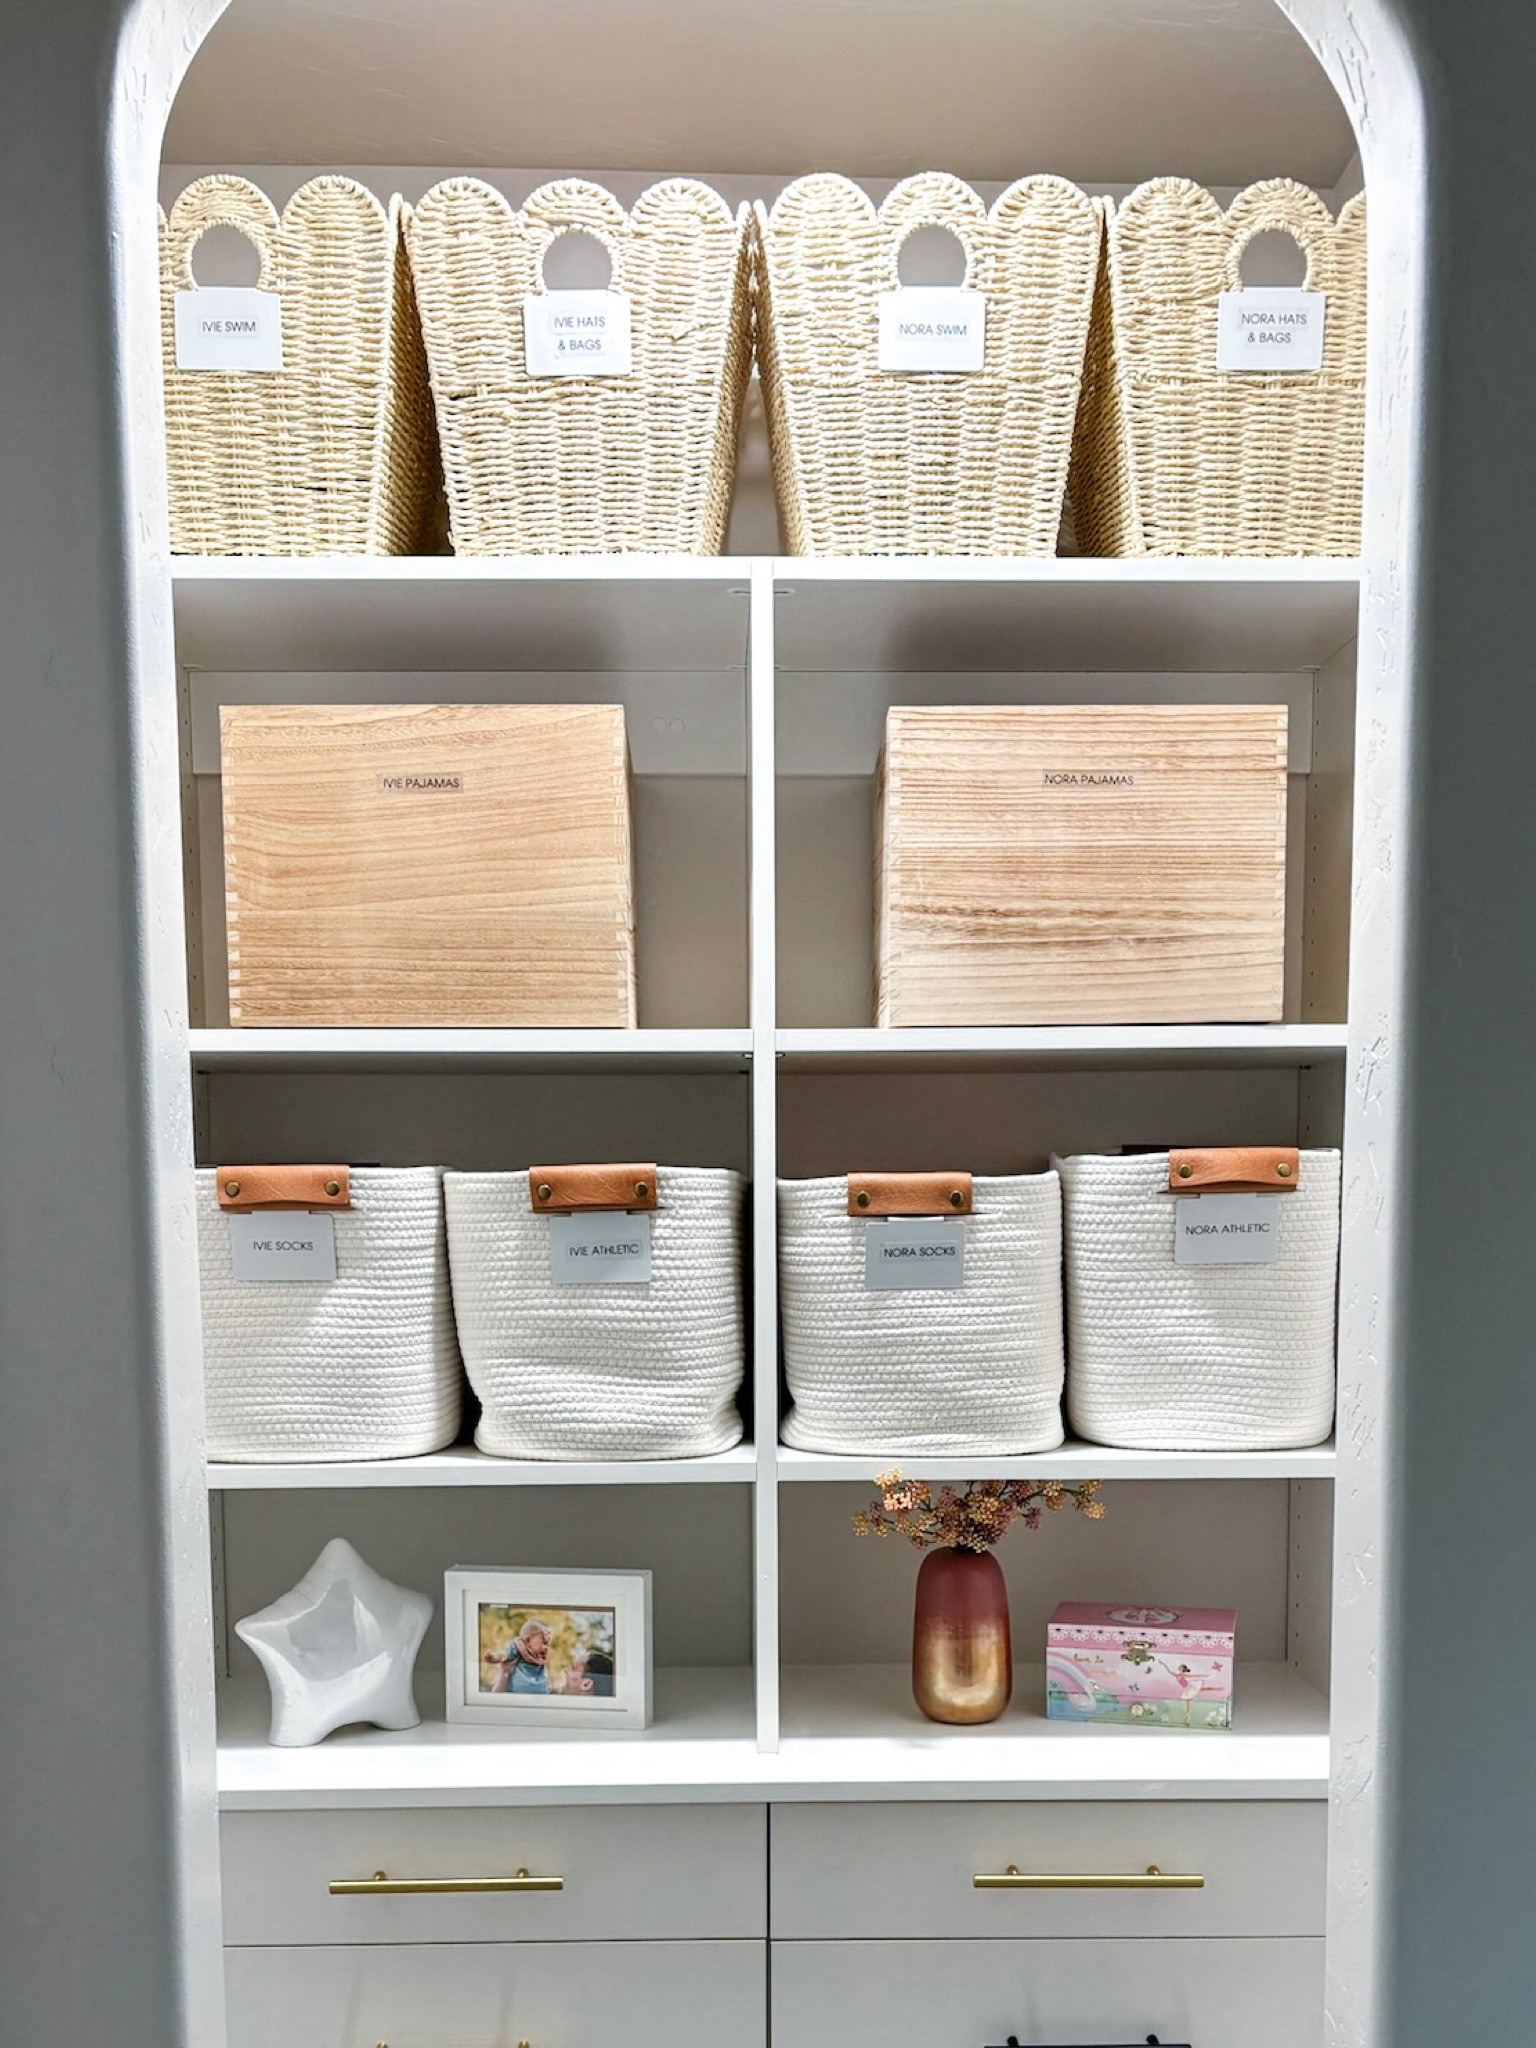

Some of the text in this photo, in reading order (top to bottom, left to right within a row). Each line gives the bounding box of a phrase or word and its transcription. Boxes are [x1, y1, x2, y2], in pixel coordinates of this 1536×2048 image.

[554, 316, 606, 328] IVIE HATS
[1241, 313, 1307, 325] NORA HATS
[202, 321, 256, 332] IVIE SWIM
[899, 323, 967, 335] NORA SWIM
[1247, 331, 1292, 343] & BAGS
[558, 339, 602, 351] & BAGS
[383, 778, 459, 788] IVIE PAJAMAS
[1044, 773, 1134, 785] NORA PAJAMAS
[1185, 1223, 1270, 1235] NORA ATHLETIC
[253, 1241, 314, 1251] IVIE SOCKS
[569, 1243, 639, 1256] IVIE ATHLETIC
[883, 1246, 956, 1257] NORA SOCKS
